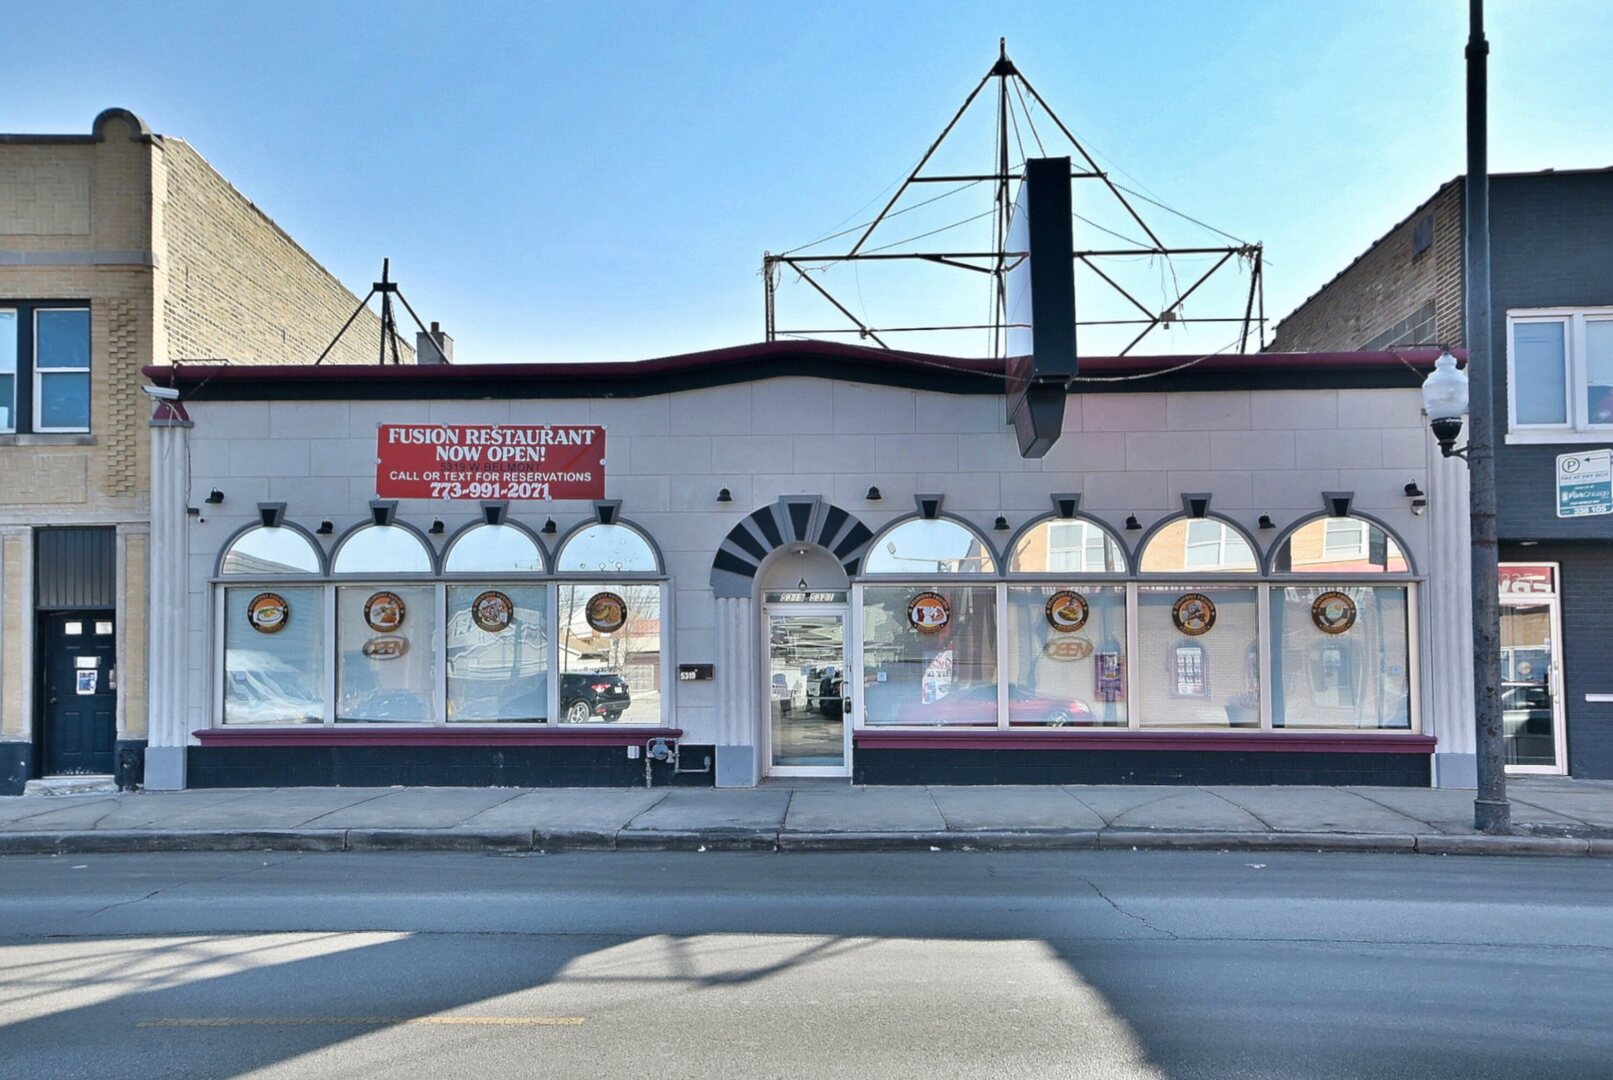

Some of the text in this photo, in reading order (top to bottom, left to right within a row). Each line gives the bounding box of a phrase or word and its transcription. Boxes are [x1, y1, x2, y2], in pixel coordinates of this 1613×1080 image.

[389, 428, 595, 445] FUSION RESTAURANT
[436, 446, 546, 462] NOW OPEN!
[440, 462, 541, 472] 5319 W BELMONT
[389, 471, 592, 482] CALL OR TEXT FOR RESERVATIONS
[430, 482, 550, 498] 773-991-2071
